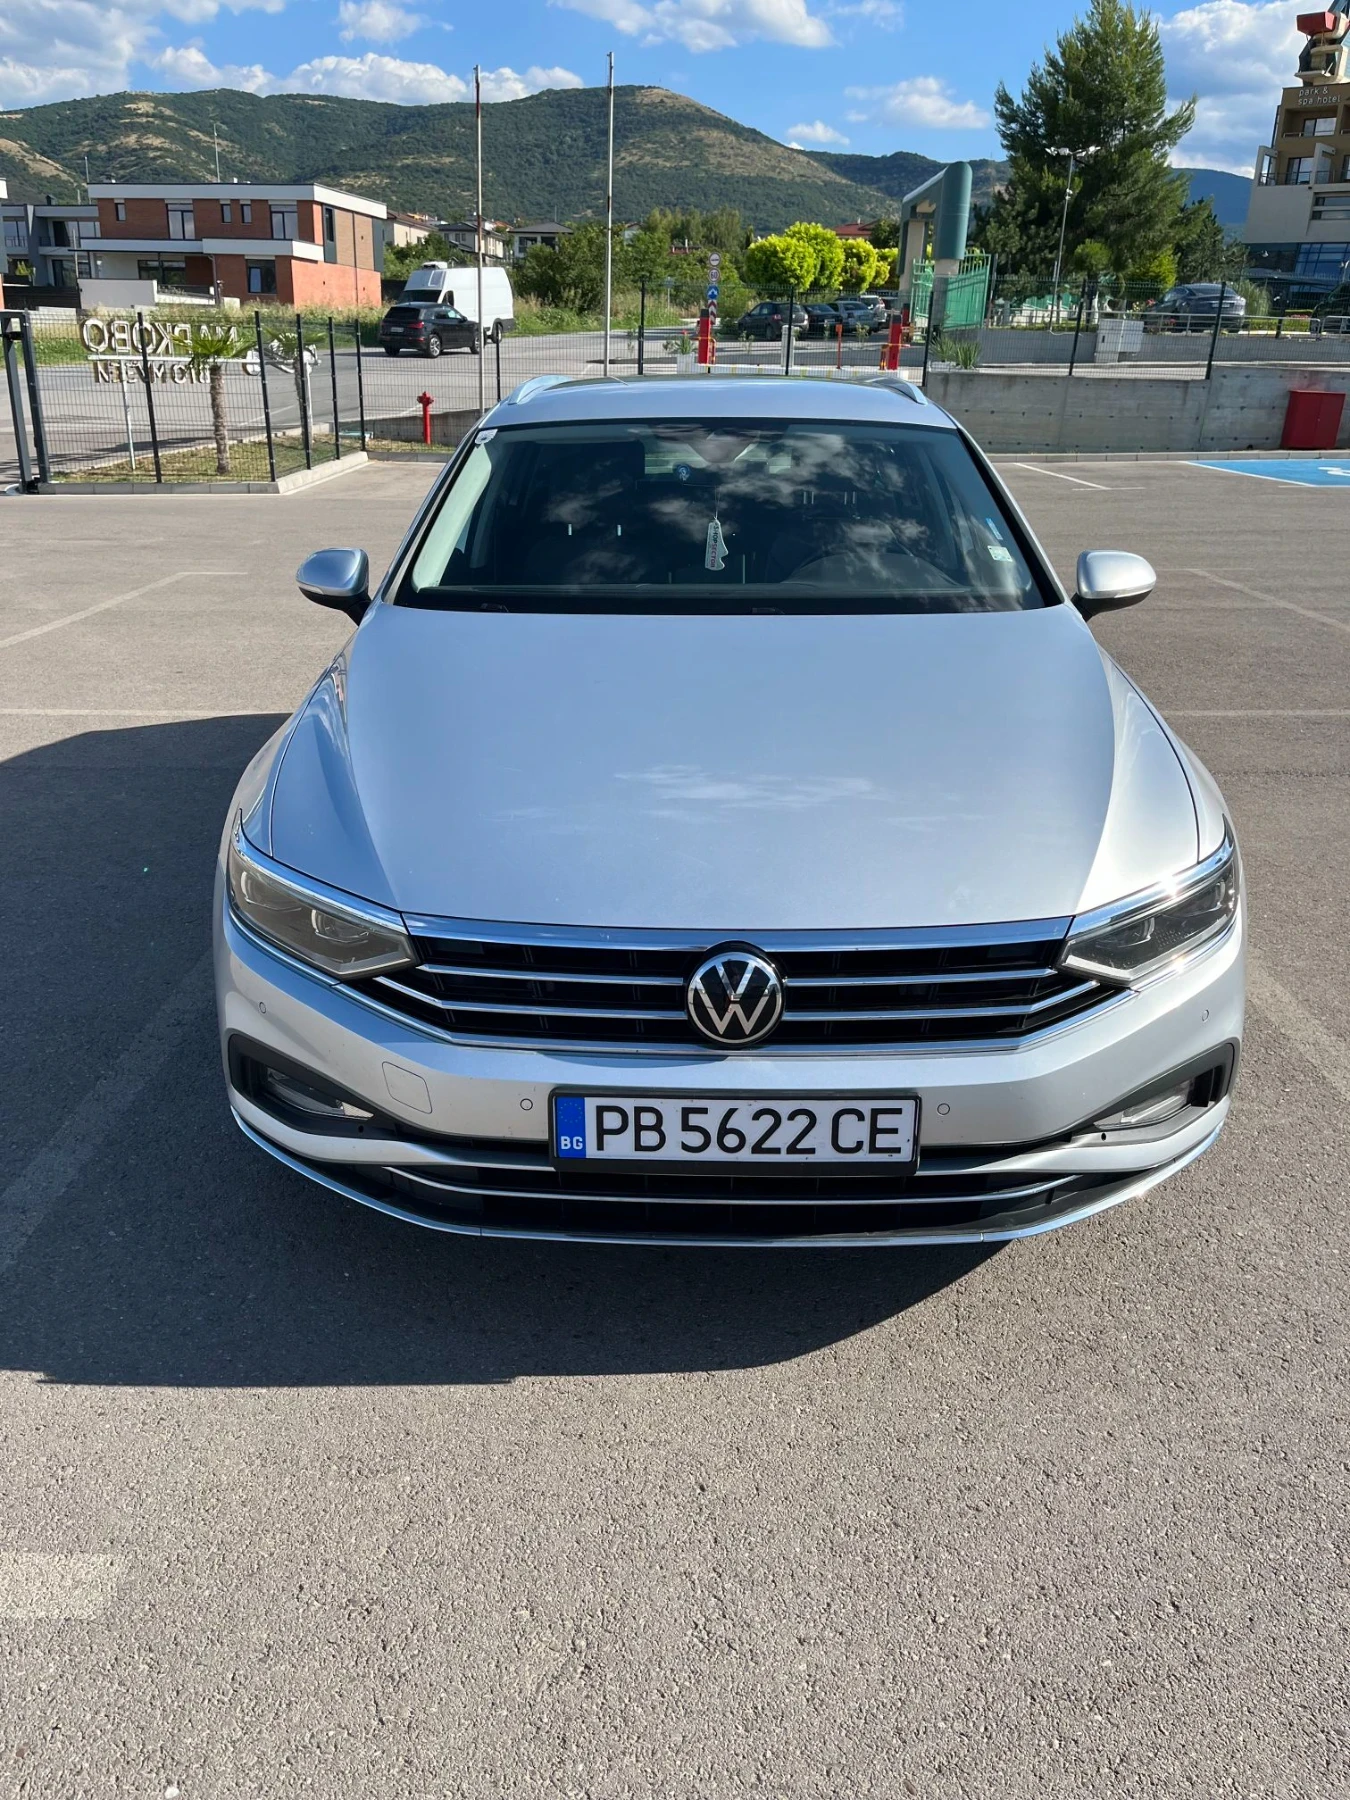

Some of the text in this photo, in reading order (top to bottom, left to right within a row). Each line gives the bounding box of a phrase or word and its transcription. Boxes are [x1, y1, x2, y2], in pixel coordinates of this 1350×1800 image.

[1299, 86, 1329, 97] park &
[1298, 95, 1341, 106] spa hotel
[560, 1135, 583, 1150] BG
